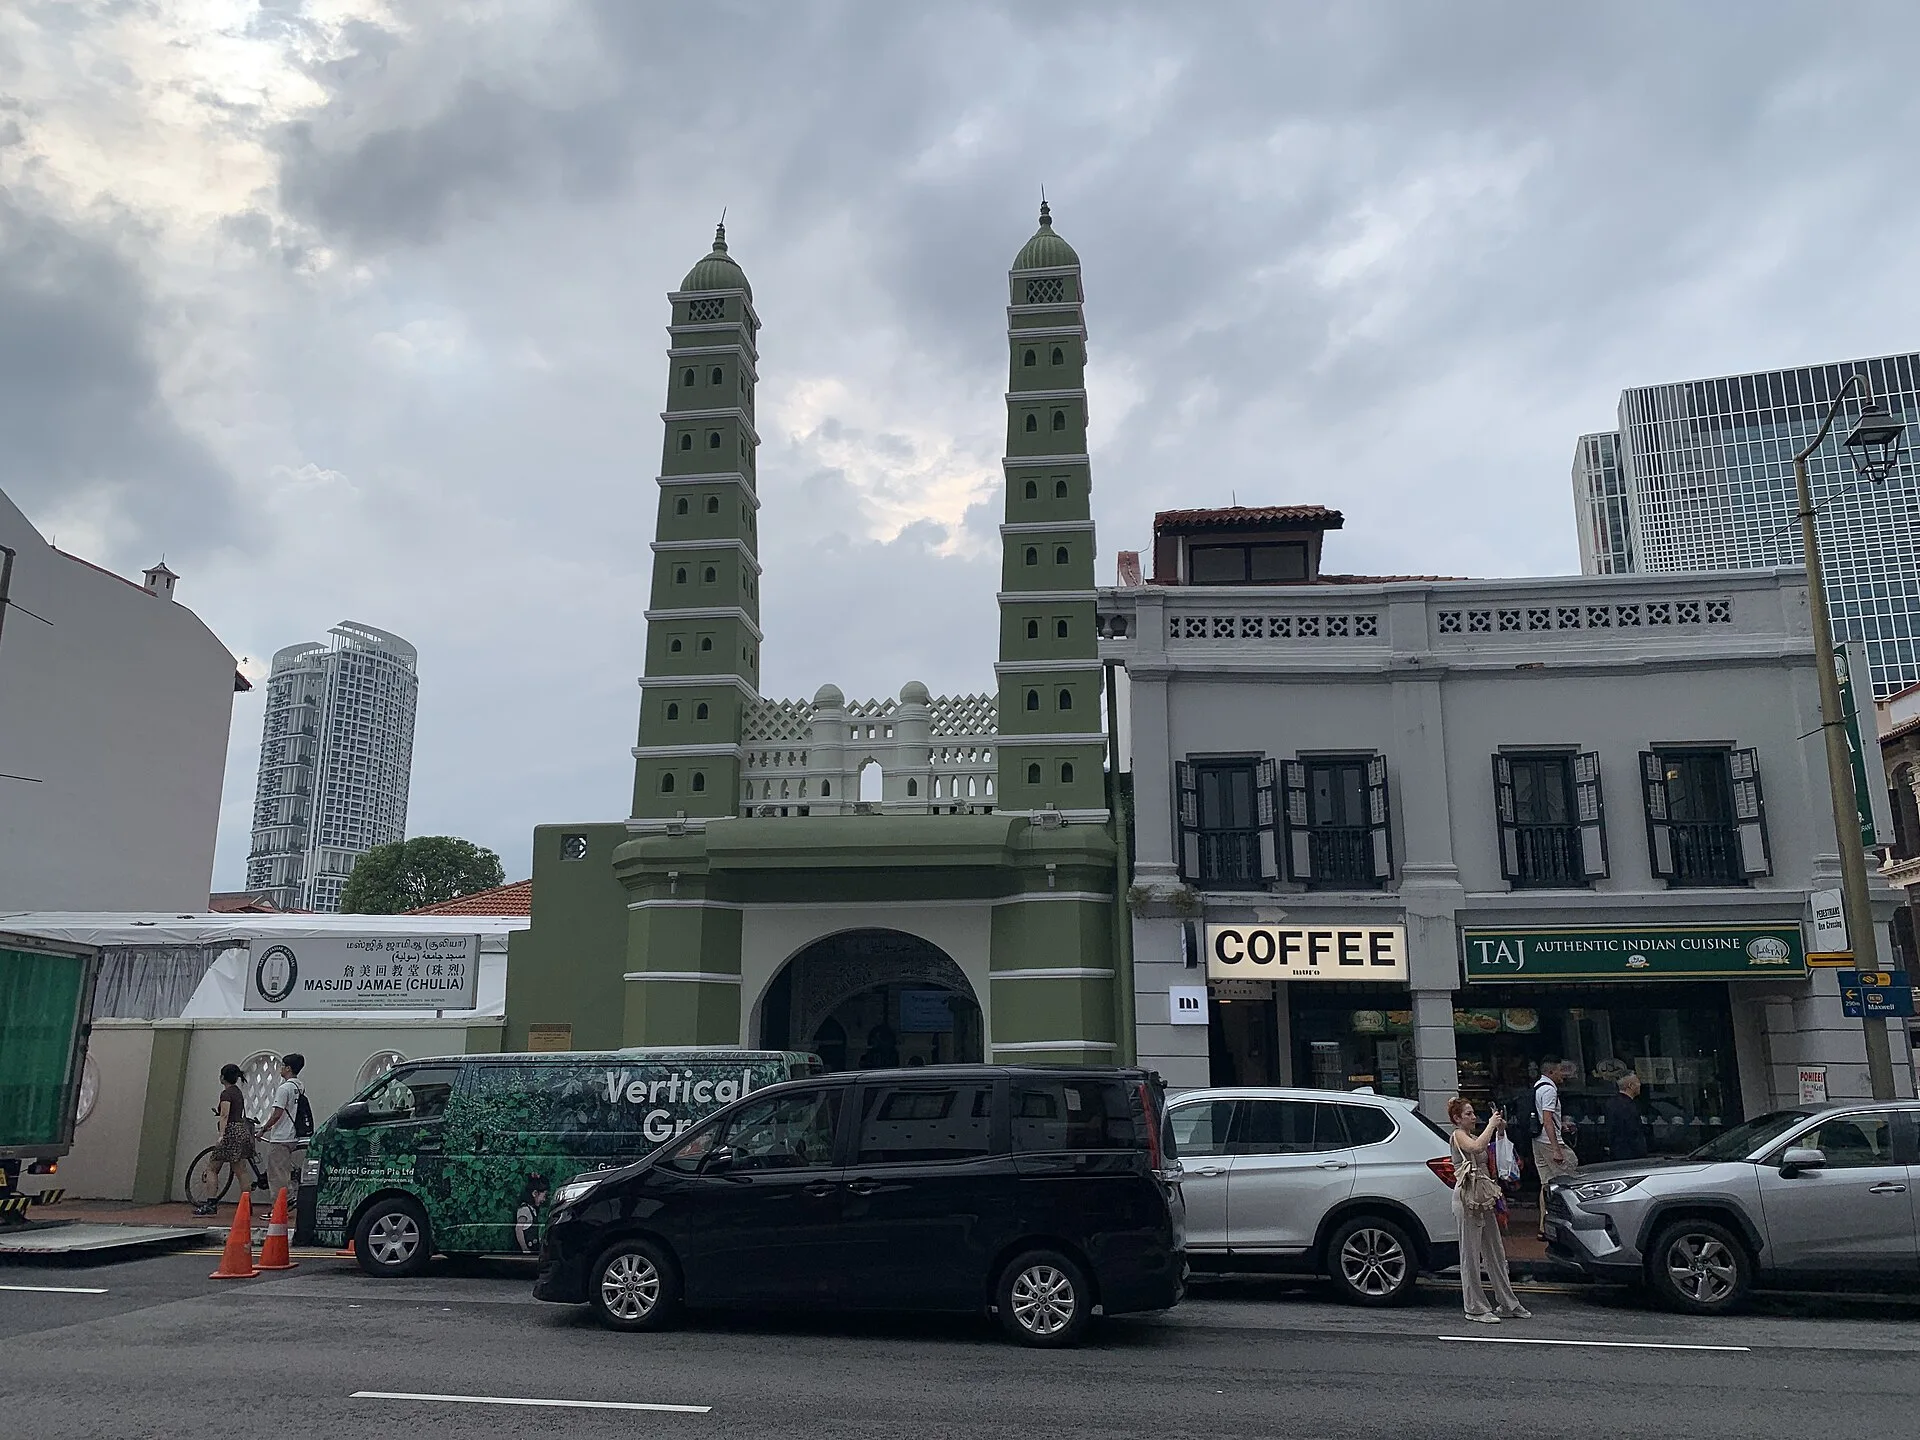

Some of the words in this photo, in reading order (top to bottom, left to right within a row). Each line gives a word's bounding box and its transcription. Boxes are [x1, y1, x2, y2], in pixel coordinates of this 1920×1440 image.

[1215, 929, 1396, 966] COFFEE
[1473, 939, 1525, 971] TAJ
[1535, 939, 1618, 952] AUTHENTIC
[1622, 939, 1677, 951] INDIAN
[1680, 938, 1740, 950] CUISINE
[304, 980, 353, 991] MASJID
[356, 979, 402, 991] JAMAE
[406, 976, 464, 991] (CHULIA)
[607, 1069, 750, 1103] Vertical
[643, 1108, 699, 1142] Gr
[329, 1166, 359, 1175] Vertical
[361, 1167, 385, 1175] Green
[387, 1167, 399, 1175] Pte
[402, 1167, 415, 1175] Ltd
